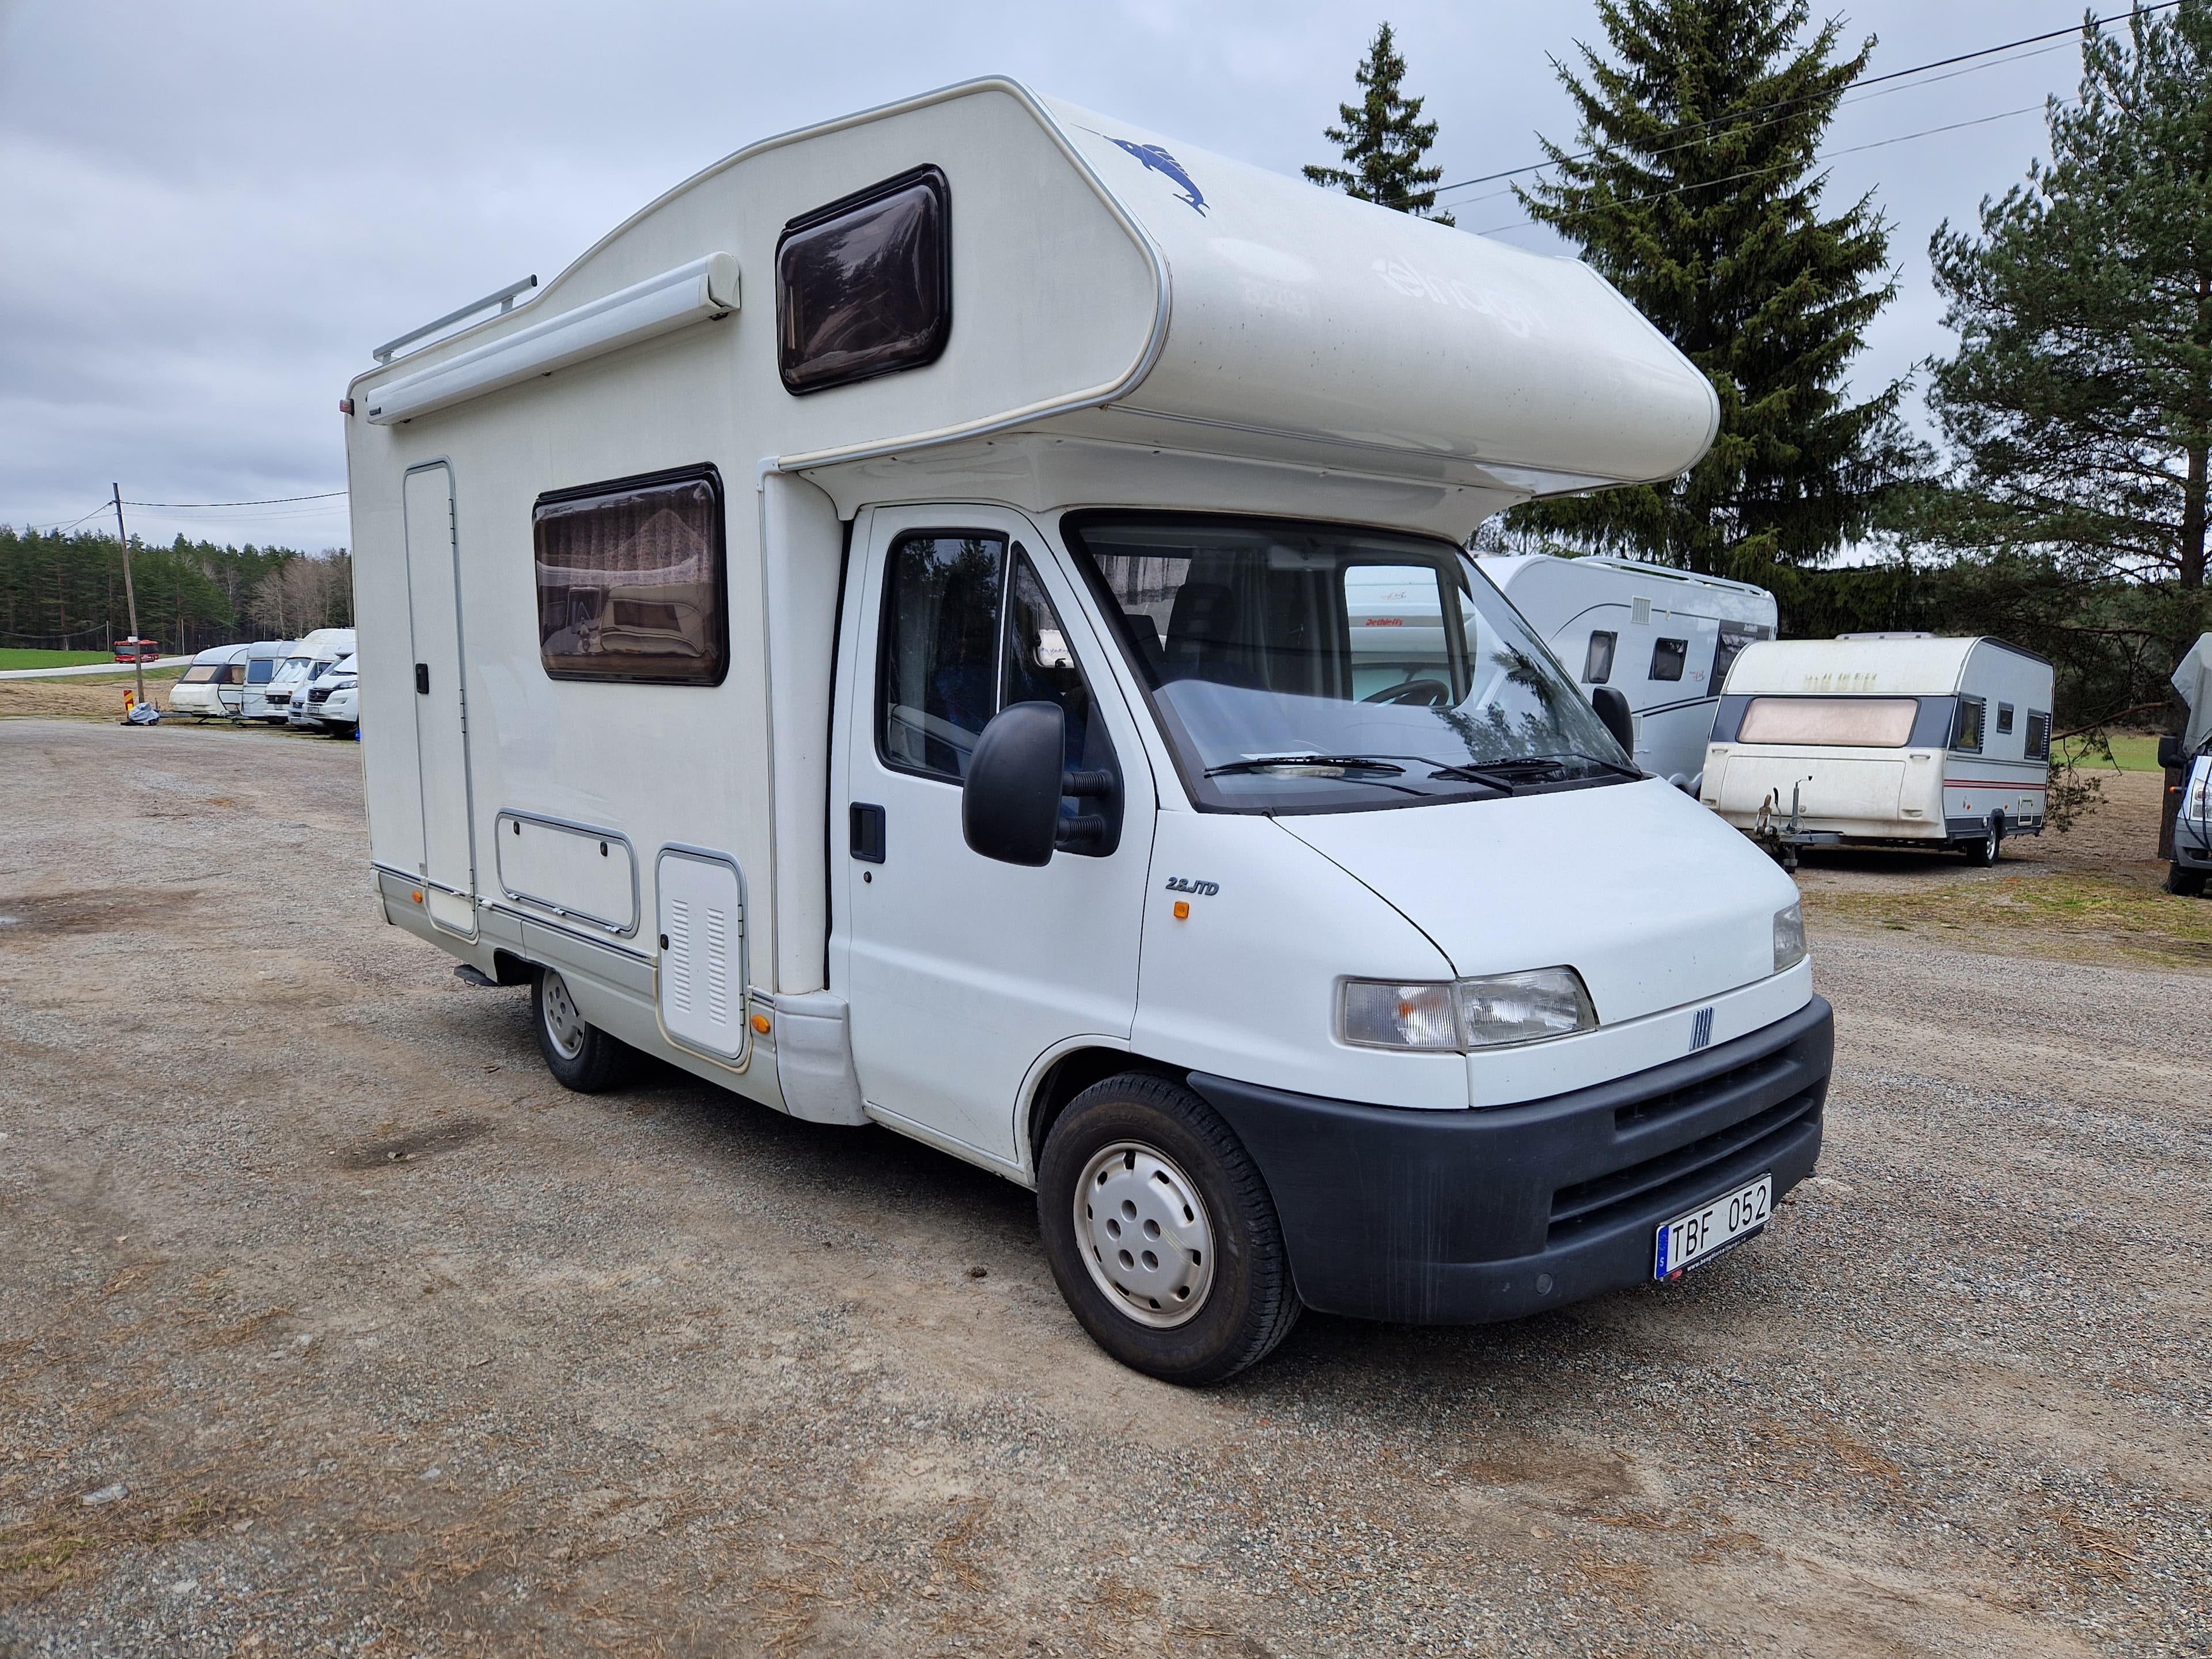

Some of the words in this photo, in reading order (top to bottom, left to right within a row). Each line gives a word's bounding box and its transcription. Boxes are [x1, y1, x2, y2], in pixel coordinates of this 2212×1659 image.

[1366, 618, 1404, 626] Dethleffs
[1672, 1210, 1713, 1263] TBF
[1729, 1184, 1767, 1233] 052
[1659, 1256, 1665, 1267] S
